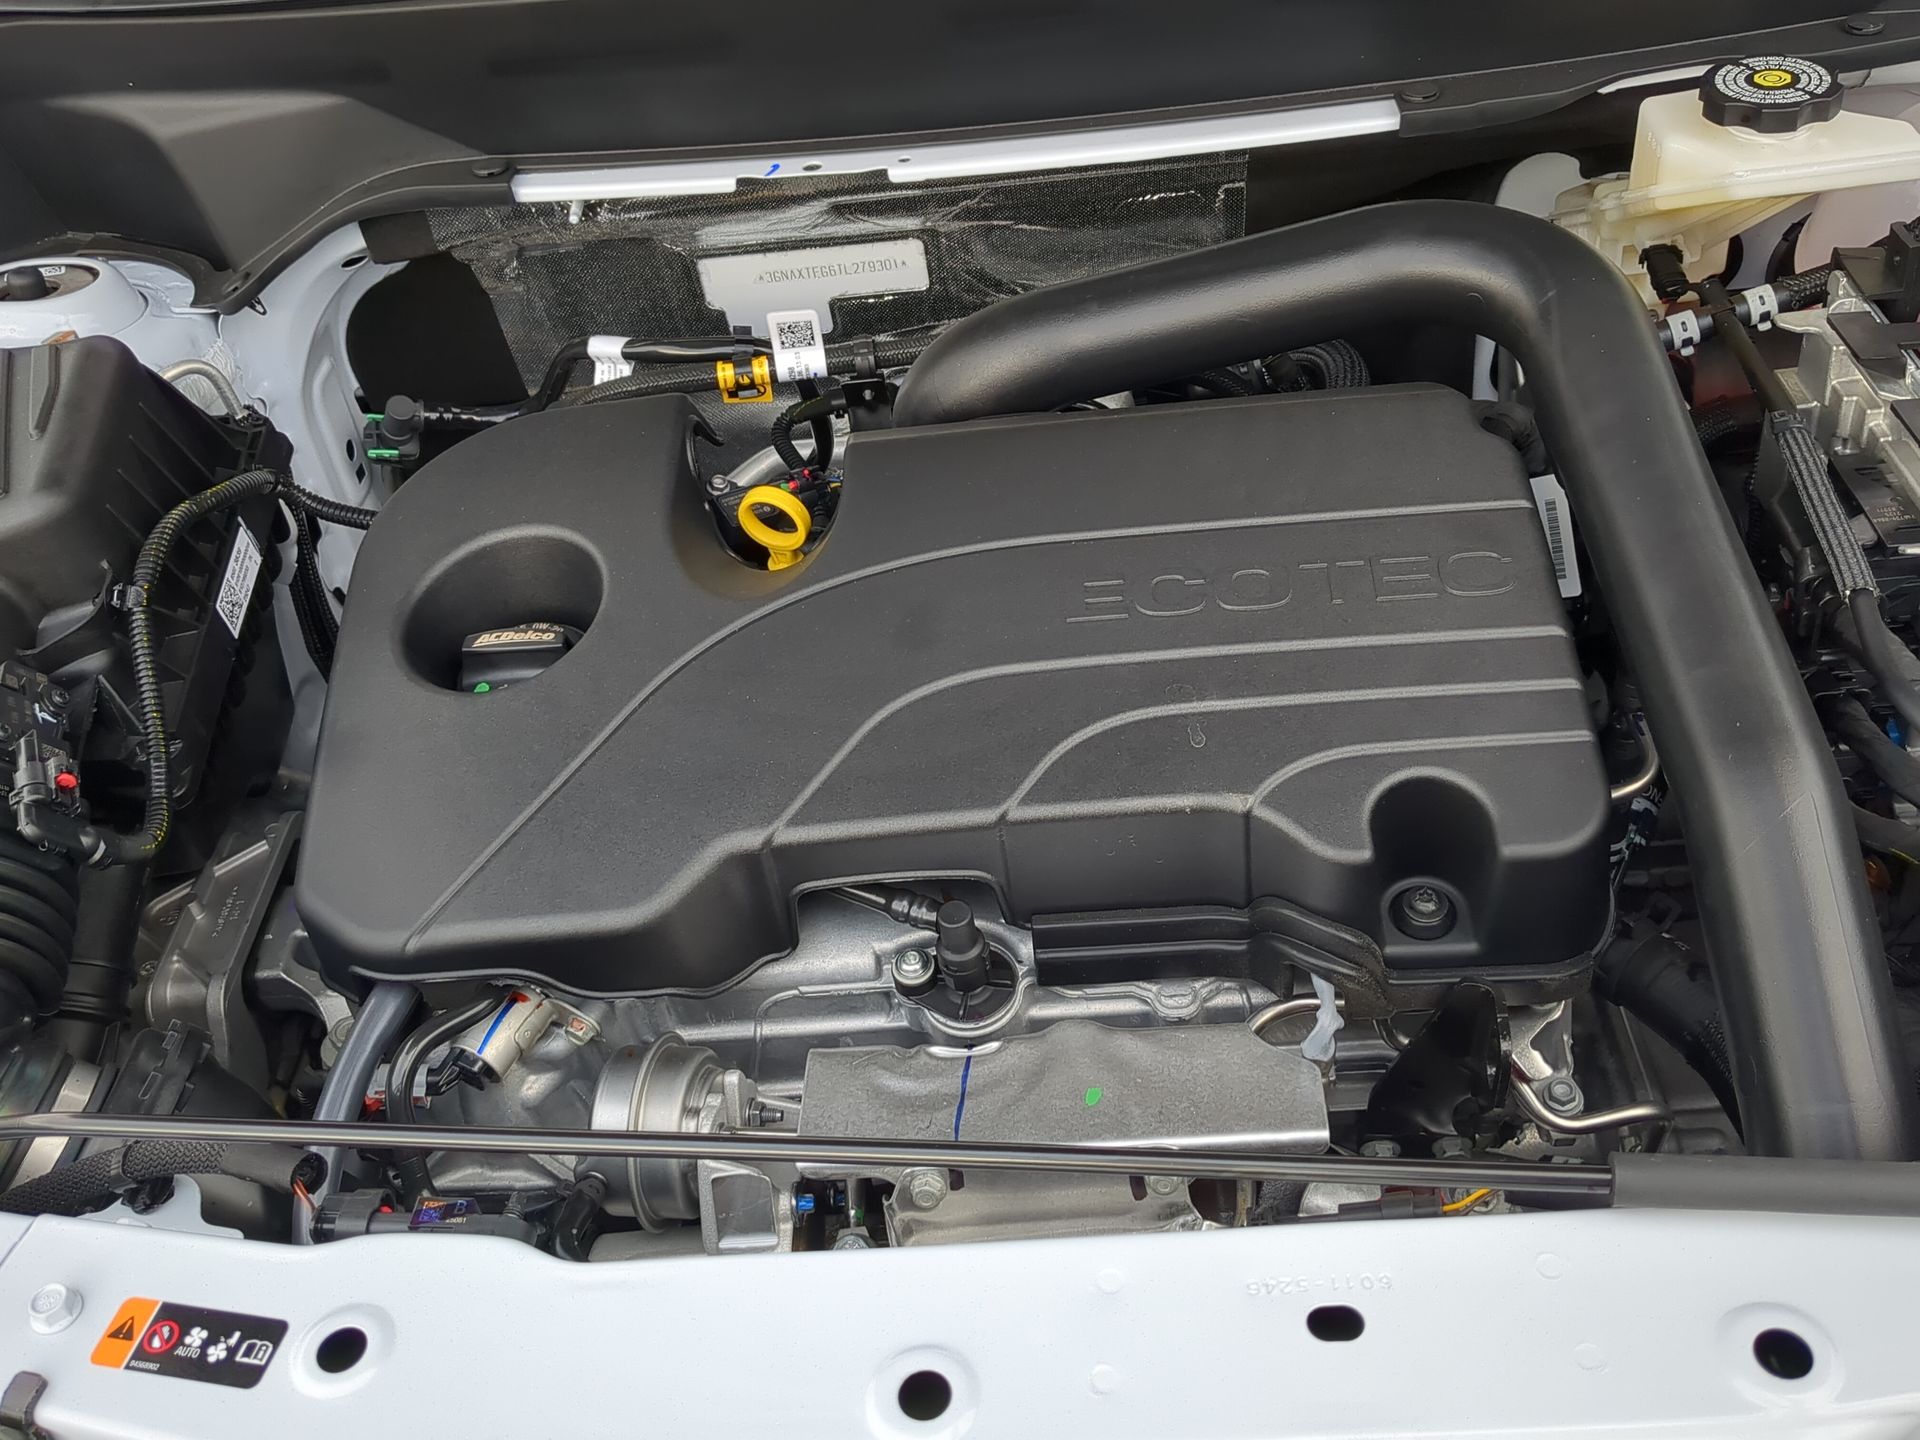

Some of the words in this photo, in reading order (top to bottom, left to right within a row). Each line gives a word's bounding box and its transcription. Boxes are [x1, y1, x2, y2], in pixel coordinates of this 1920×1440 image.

[1066, 551, 1517, 623] ECOTEC
[475, 630, 556, 645] ACDelco
[453, 1199, 467, 1214] B
[174, 1345, 201, 1359] AUTO
